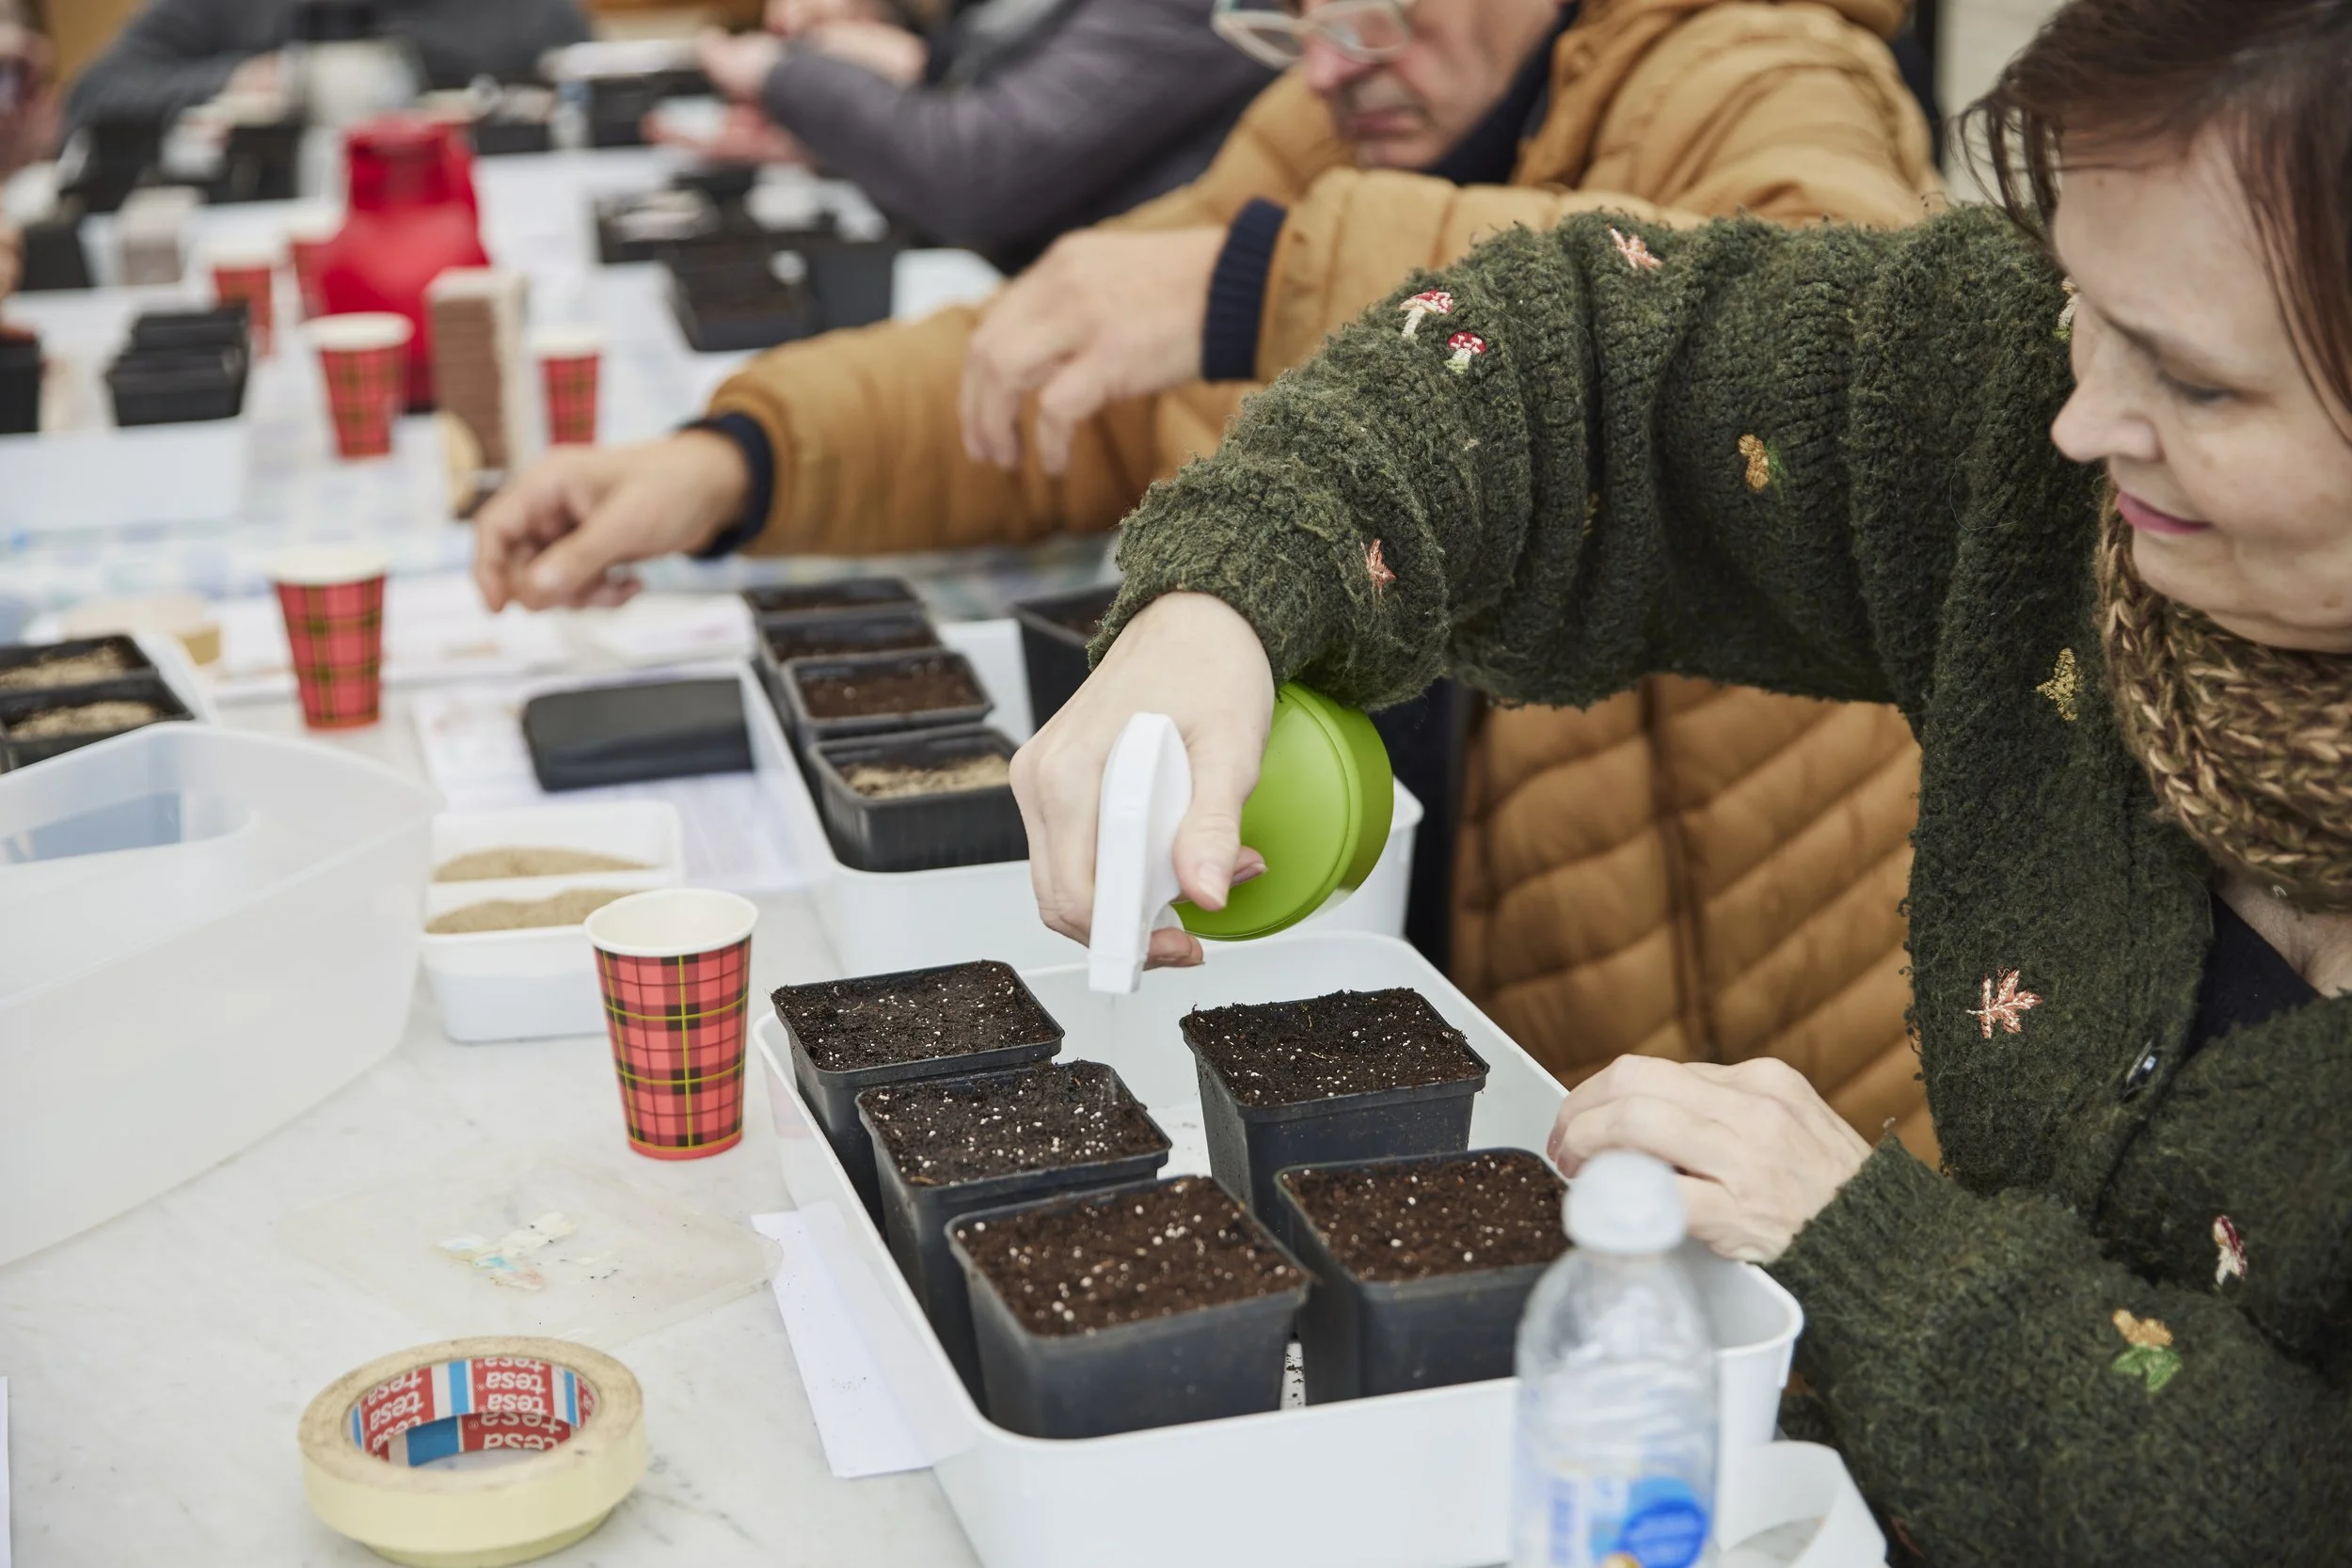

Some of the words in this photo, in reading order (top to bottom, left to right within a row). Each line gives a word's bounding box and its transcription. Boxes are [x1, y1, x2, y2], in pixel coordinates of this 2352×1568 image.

[485, 1371, 546, 1394] tesa
[370, 1391, 424, 1431] tesa
[487, 1393, 548, 1416] tesa
